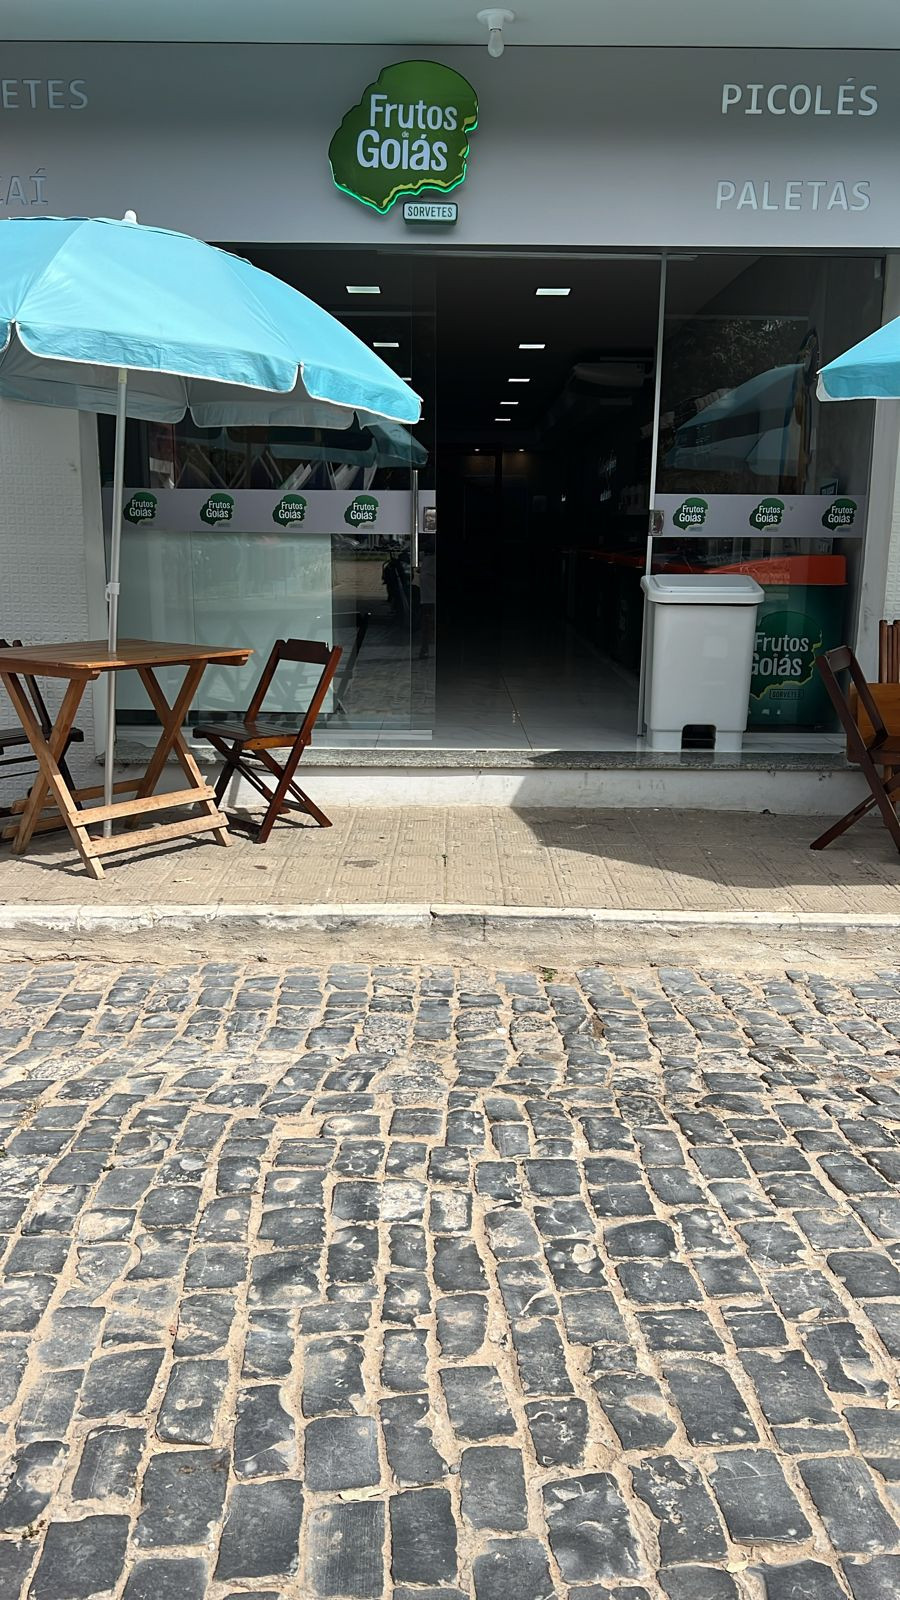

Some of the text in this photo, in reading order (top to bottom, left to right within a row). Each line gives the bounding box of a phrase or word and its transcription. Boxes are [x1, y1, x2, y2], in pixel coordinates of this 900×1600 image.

[721, 76, 879, 116] PICOLÉS
[370, 94, 458, 131] Frutos
[356, 129, 448, 171] Goiás
[0, 167, 49, 206] AÍ
[715, 179, 871, 211] PALETAS
[407, 206, 453, 218] SORVETES
[131, 499, 154, 509] Frutos
[208, 500, 231, 510] Frutos
[281, 501, 303, 510] Frutos
[353, 502, 375, 511] Frutos
[682, 504, 704, 513] Frutos
[129, 507, 152, 517] Goiás
[206, 508, 229, 518] Goiás
[278, 509, 301, 519] Goiás
[758, 505, 781, 514] Frutos
[831, 505, 853, 514] Frutos
[350, 510, 373, 520] Goiás
[678, 513, 702, 522] Goiás
[755, 513, 778, 523] Goiás
[827, 514, 850, 523] Goiás
[754, 632, 809, 652] Frutos
